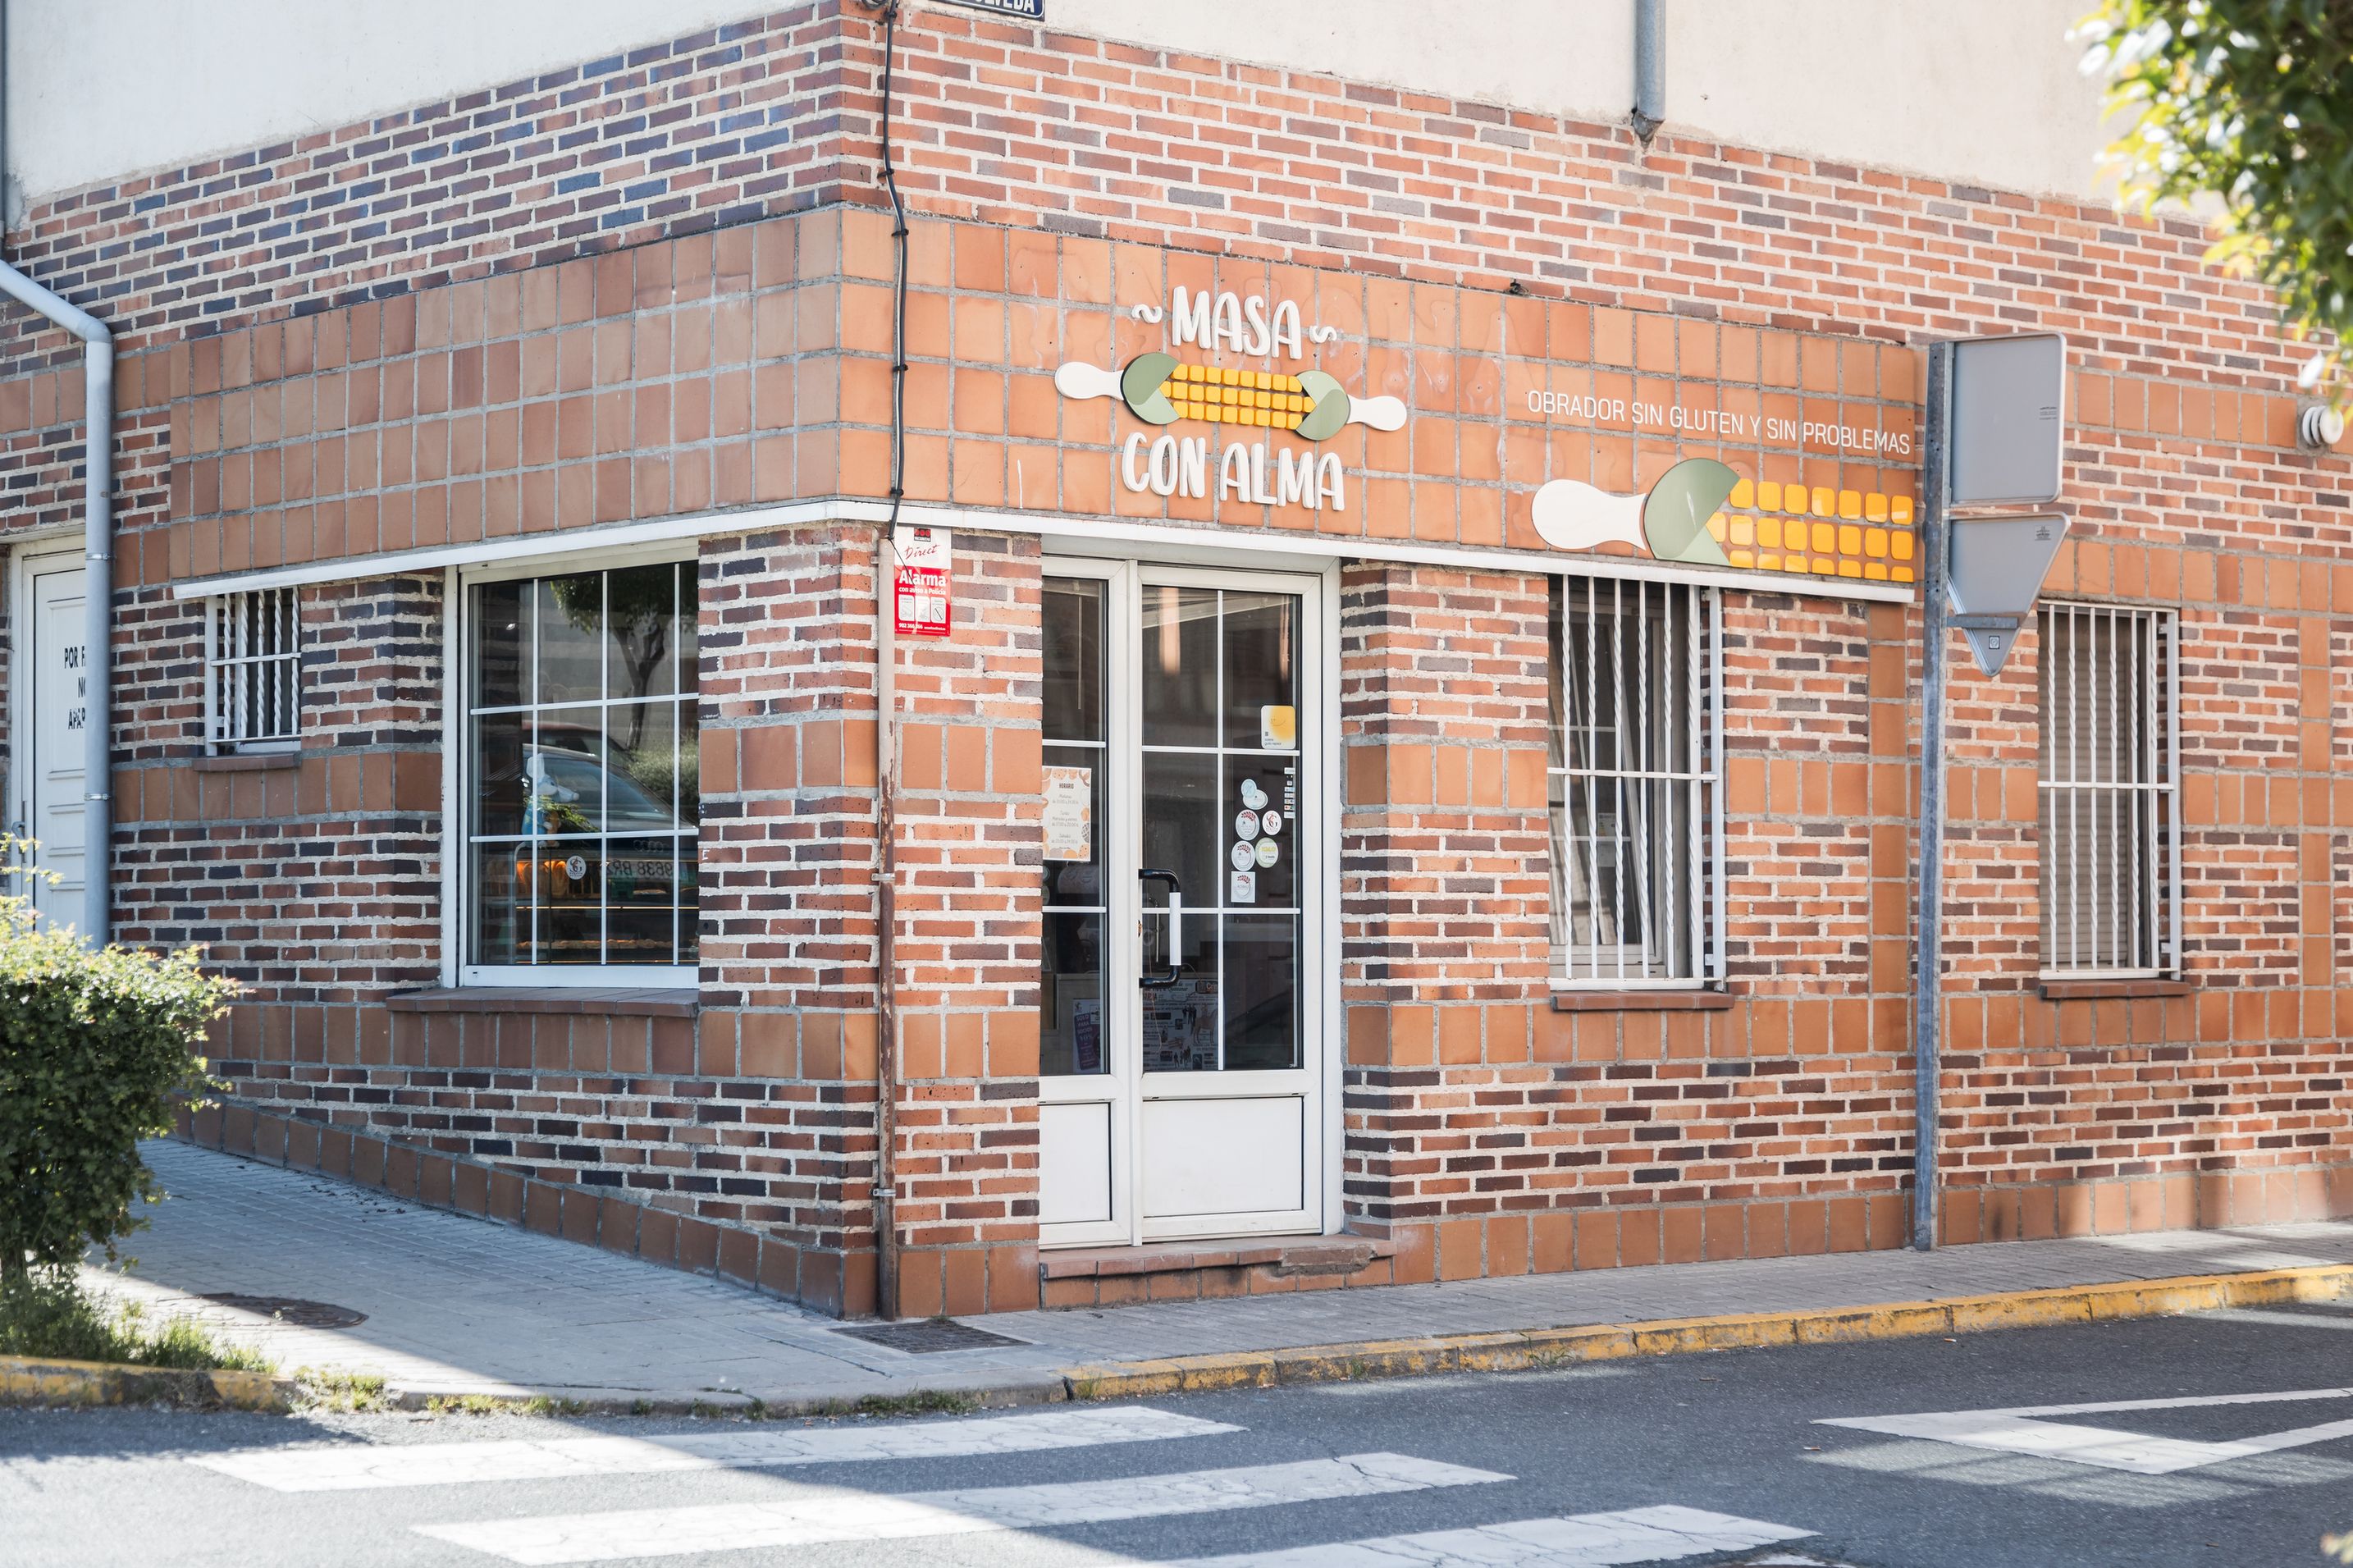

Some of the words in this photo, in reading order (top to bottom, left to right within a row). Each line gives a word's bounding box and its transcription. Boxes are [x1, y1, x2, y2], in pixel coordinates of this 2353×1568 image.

[1172, 286, 1303, 359] MASA
[1527, 390, 1625, 423] OBRADOR
[1632, 402, 1663, 427] SIN
[1670, 406, 1743, 436] GLUTEN
[1749, 416, 1761, 437] Y
[1766, 418, 1797, 442] SIN
[1802, 422, 1910, 455] PROBLEMAS
[1122, 432, 1206, 499] CON
[1220, 442, 1346, 511] ALMA
[905, 544, 940, 560] Direct
[899, 569, 946, 587] Alarma
[65, 647, 79, 669] POR
